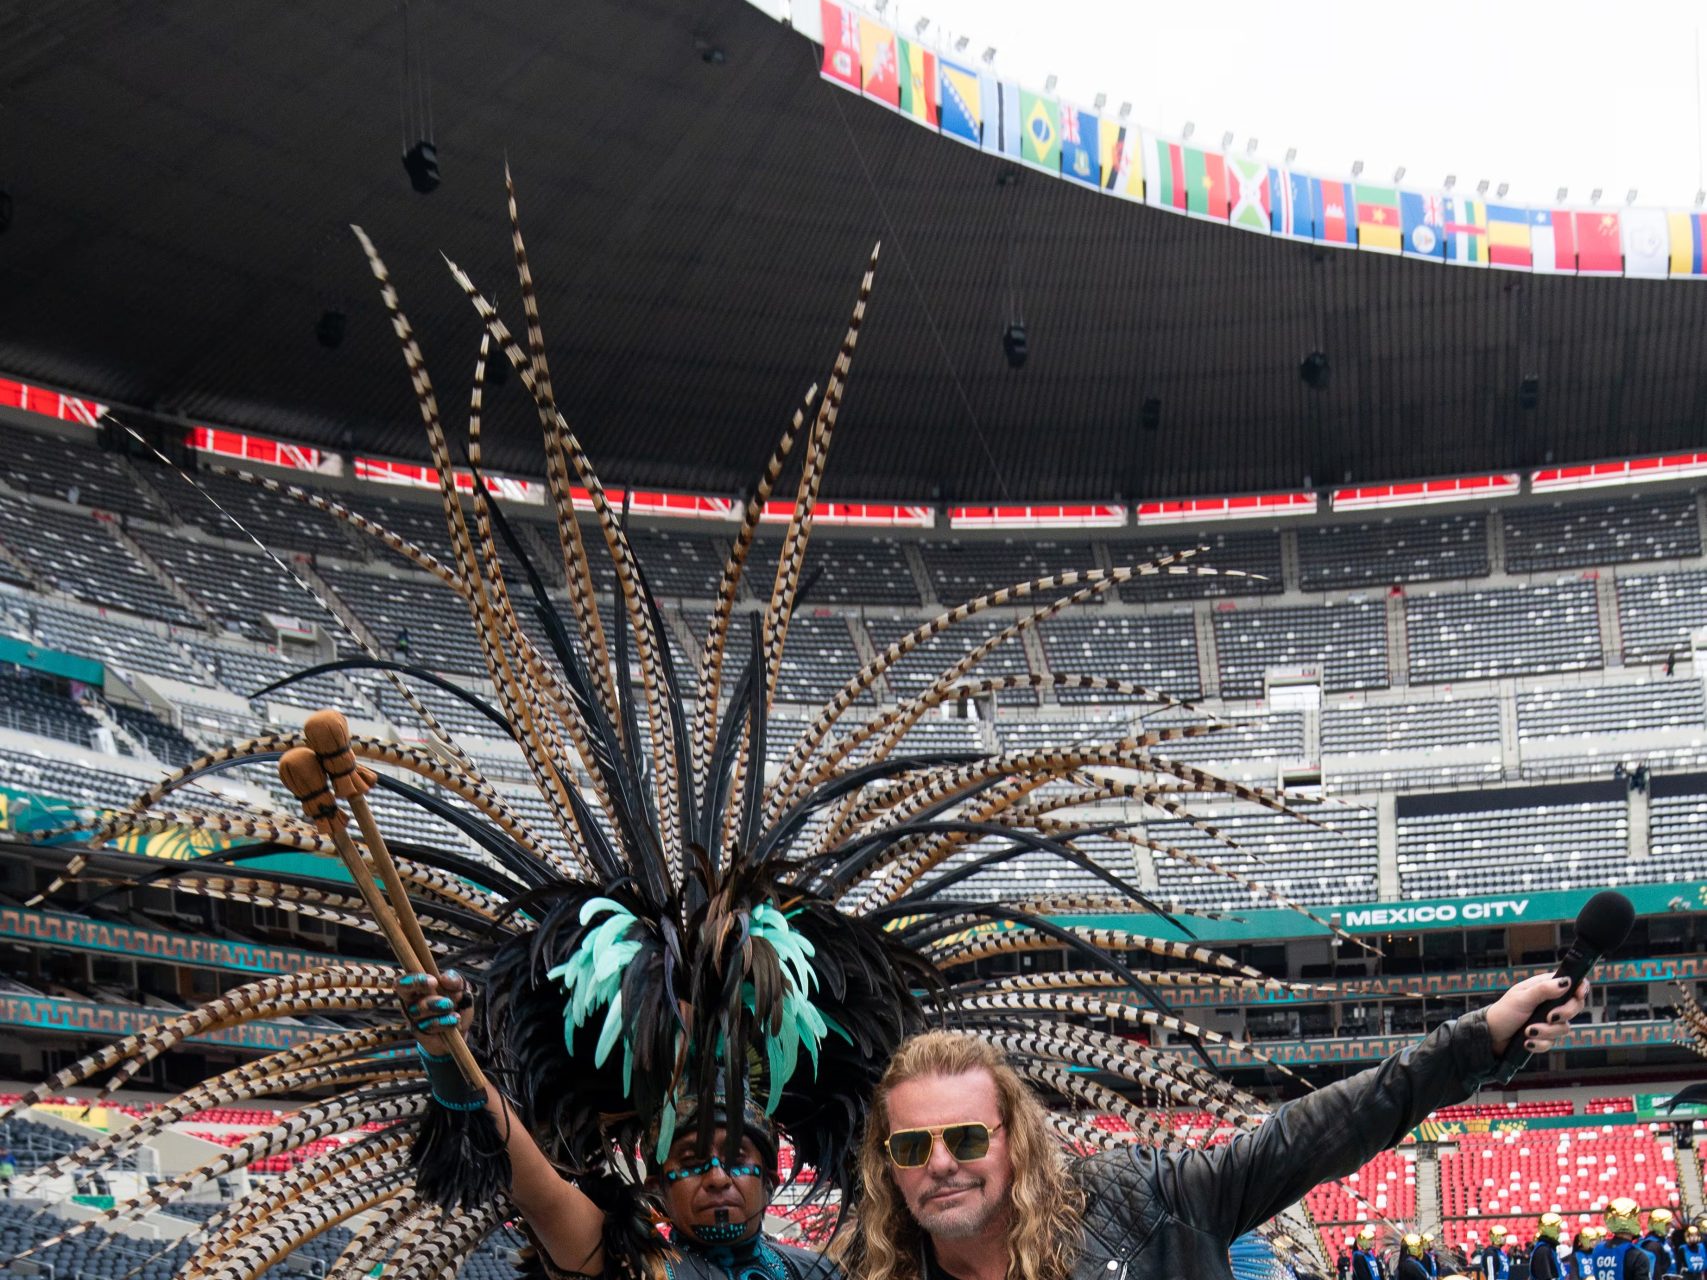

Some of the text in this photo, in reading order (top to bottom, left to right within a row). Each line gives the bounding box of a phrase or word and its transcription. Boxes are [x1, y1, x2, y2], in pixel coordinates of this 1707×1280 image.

[1346, 900, 1529, 927] MEXICO CITY
[66, 920, 111, 946] FIFA
[191, 939, 234, 963] FIFA
[1466, 970, 1511, 990] FIFA
[1595, 963, 1639, 981] FIFA
[1218, 985, 1262, 1001] FIFA
[1342, 979, 1386, 996] FIFA
[238, 1024, 278, 1046] FIFA
[1642, 1024, 1688, 1042] FIFA
[1266, 1045, 1309, 1062] FIFA
[1596, 1255, 1618, 1268] GOL
